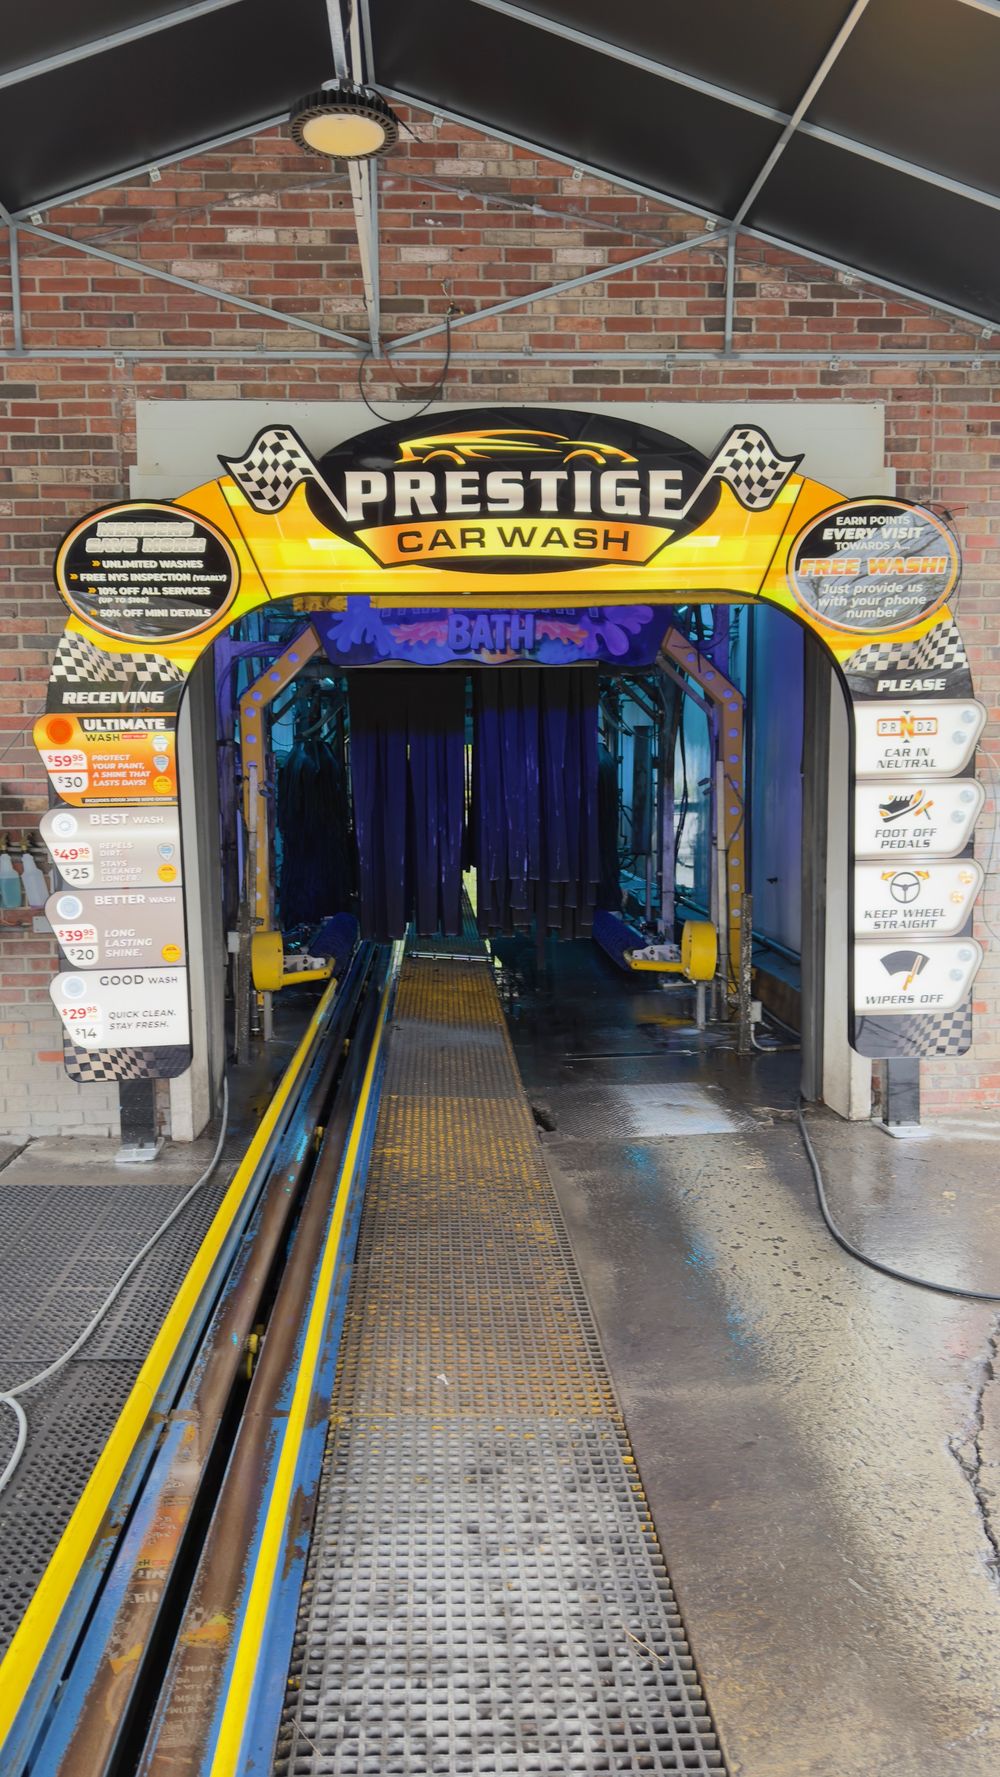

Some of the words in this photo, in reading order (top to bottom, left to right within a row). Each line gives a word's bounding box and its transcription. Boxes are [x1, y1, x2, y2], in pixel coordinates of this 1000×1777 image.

[344, 471, 684, 522] PRESTIGE
[836, 516, 867, 525] EARN
[869, 515, 910, 525] POINTS
[822, 527, 878, 540] EVERY
[881, 527, 924, 540] VISIT
[397, 527, 487, 554] CAR
[496, 526, 630, 552] WASH
[834, 541, 890, 551] TOWARDS
[102, 560, 157, 569] UNLIMITED
[159, 560, 204, 568] WASHES
[799, 558, 860, 577] FREE
[866, 556, 948, 576] WASH!
[80, 573, 107, 582] FREE
[108, 573, 129, 582] NYS
[131, 573, 191, 581] INSPECTION
[98, 587, 118, 596] 10%
[119, 587, 141, 595] OFF
[141, 587, 159, 595] ALL
[162, 587, 211, 595] SERVICES
[821, 584, 849, 594] Just
[853, 582, 903, 596] provide
[907, 584, 923, 593] us
[819, 596, 847, 606] with
[851, 597, 881, 608] your
[884, 595, 927, 608] phone
[100, 609, 121, 618] 50%
[123, 609, 144, 617] OFF
[145, 609, 169, 617] MINI
[170, 609, 212, 617] DETAILS
[846, 608, 898, 618] number
[449, 614, 535, 652] BATH
[876, 679, 947, 692] PLEASE
[62, 691, 165, 705] RECEIVING
[83, 718, 166, 731] ULTIMATE
[85, 733, 121, 742] WASH
[884, 748, 911, 758] CAR
[916, 748, 930, 756] IN
[876, 759, 937, 769] NEUTRAL
[102, 770, 127, 778] SHINE
[58, 776, 83, 788] $30
[93, 779, 120, 787] LASTS
[89, 814, 129, 825] BEST
[133, 816, 164, 824] WASH
[875, 829, 907, 838] FOOT
[912, 828, 937, 837] OFF
[880, 839, 931, 849] PEDALS
[65, 868, 89, 879] $25
[94, 895, 146, 905] BETTER
[148, 896, 176, 904] WASH
[864, 909, 897, 919] KEEP
[903, 908, 947, 918] WHEEL
[873, 919, 938, 929] STRAIGHT
[104, 929, 136, 938] LONG
[104, 938, 153, 947] LASTING
[70, 949, 94, 960] $20
[105, 949, 143, 958] SHINE.
[99, 974, 144, 986] GOOD
[148, 976, 178, 984] WASH
[865, 995, 915, 1004] WIPERS
[920, 994, 944, 1003] OFF
[108, 1010, 139, 1019] QUICK
[142, 1009, 176, 1018] CLEAN.
[109, 1022, 131, 1030] STAY
[135, 1021, 169, 1030] FRESH.
[75, 1027, 97, 1039] $14
